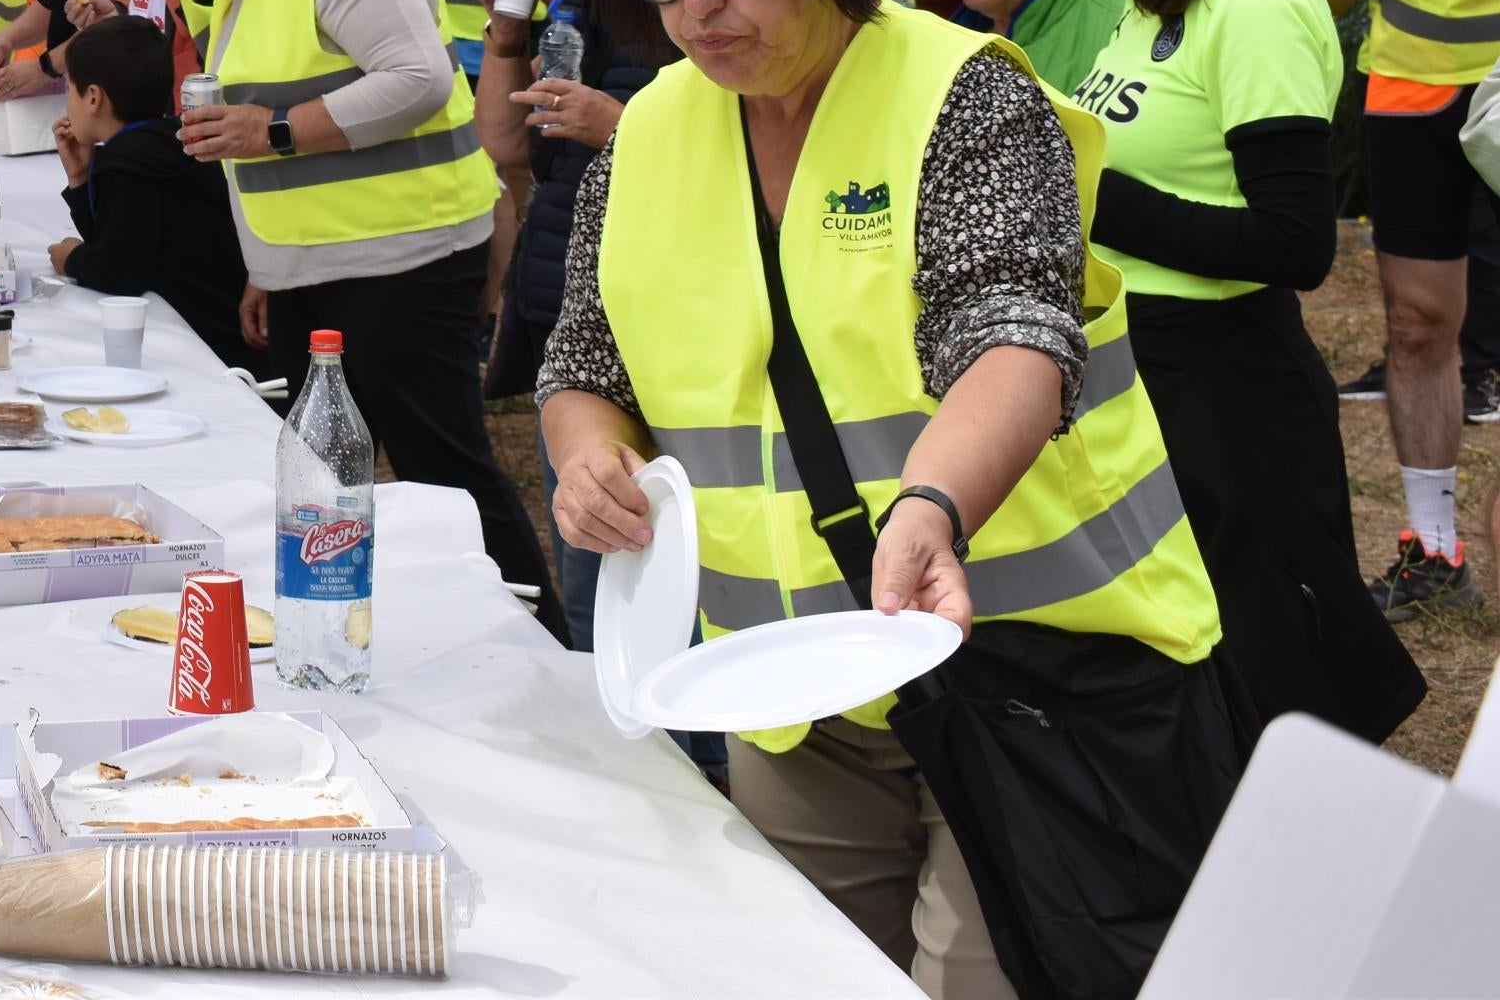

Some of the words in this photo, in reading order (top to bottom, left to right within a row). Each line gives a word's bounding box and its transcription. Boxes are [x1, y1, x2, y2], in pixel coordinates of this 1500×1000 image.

[1074, 68, 1148, 123] ARIS
[839, 228, 892, 241] VILLAMAYOR
[168, 543, 207, 553] HORNAZOS
[300, 519, 363, 564] Casera
[77, 552, 111, 566] ADYPA
[112, 551, 141, 565] MATA
[175, 552, 200, 561] DULCES
[178, 580, 214, 709] Coca-Cola
[332, 831, 387, 841] HORNAZOS
